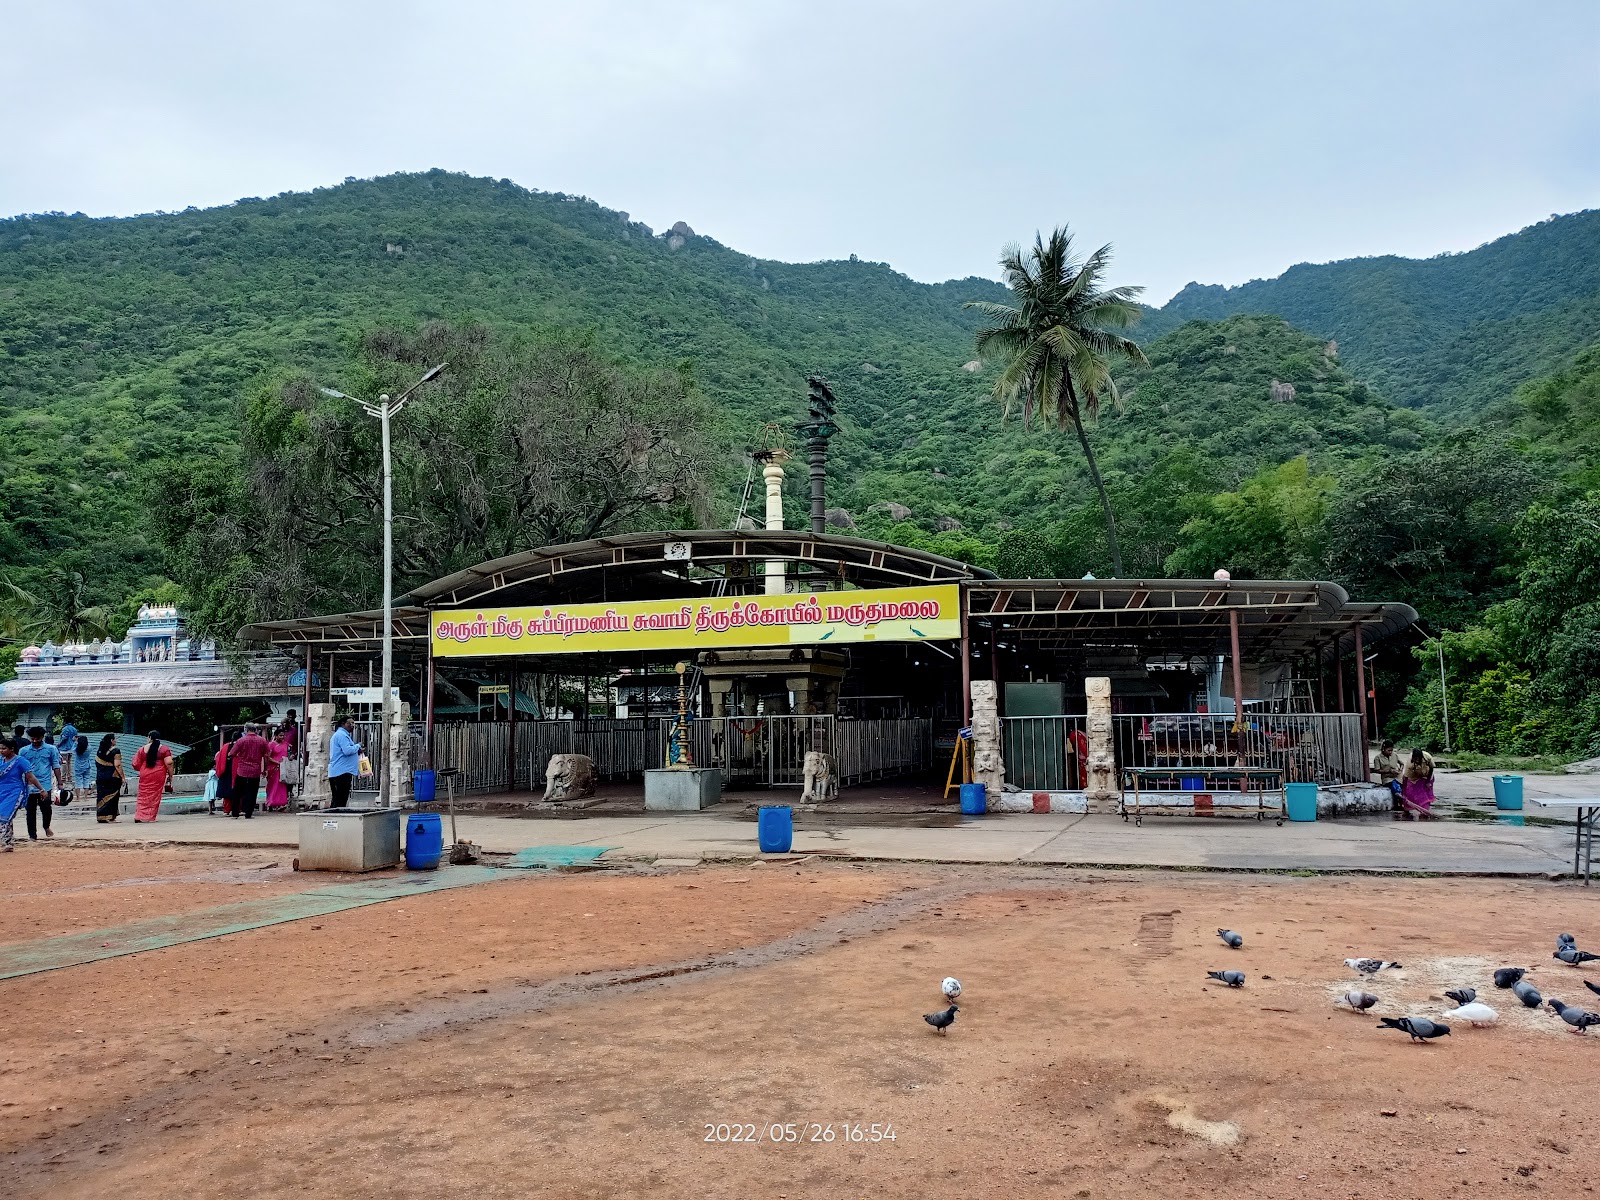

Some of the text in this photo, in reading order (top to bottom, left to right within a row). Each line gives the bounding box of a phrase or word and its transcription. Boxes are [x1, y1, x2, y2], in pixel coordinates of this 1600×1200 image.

[436, 596, 940, 642] அருள் மிகு சுப்பிரமணிய சுவாமி திருக்கோயில் மருதமலை
